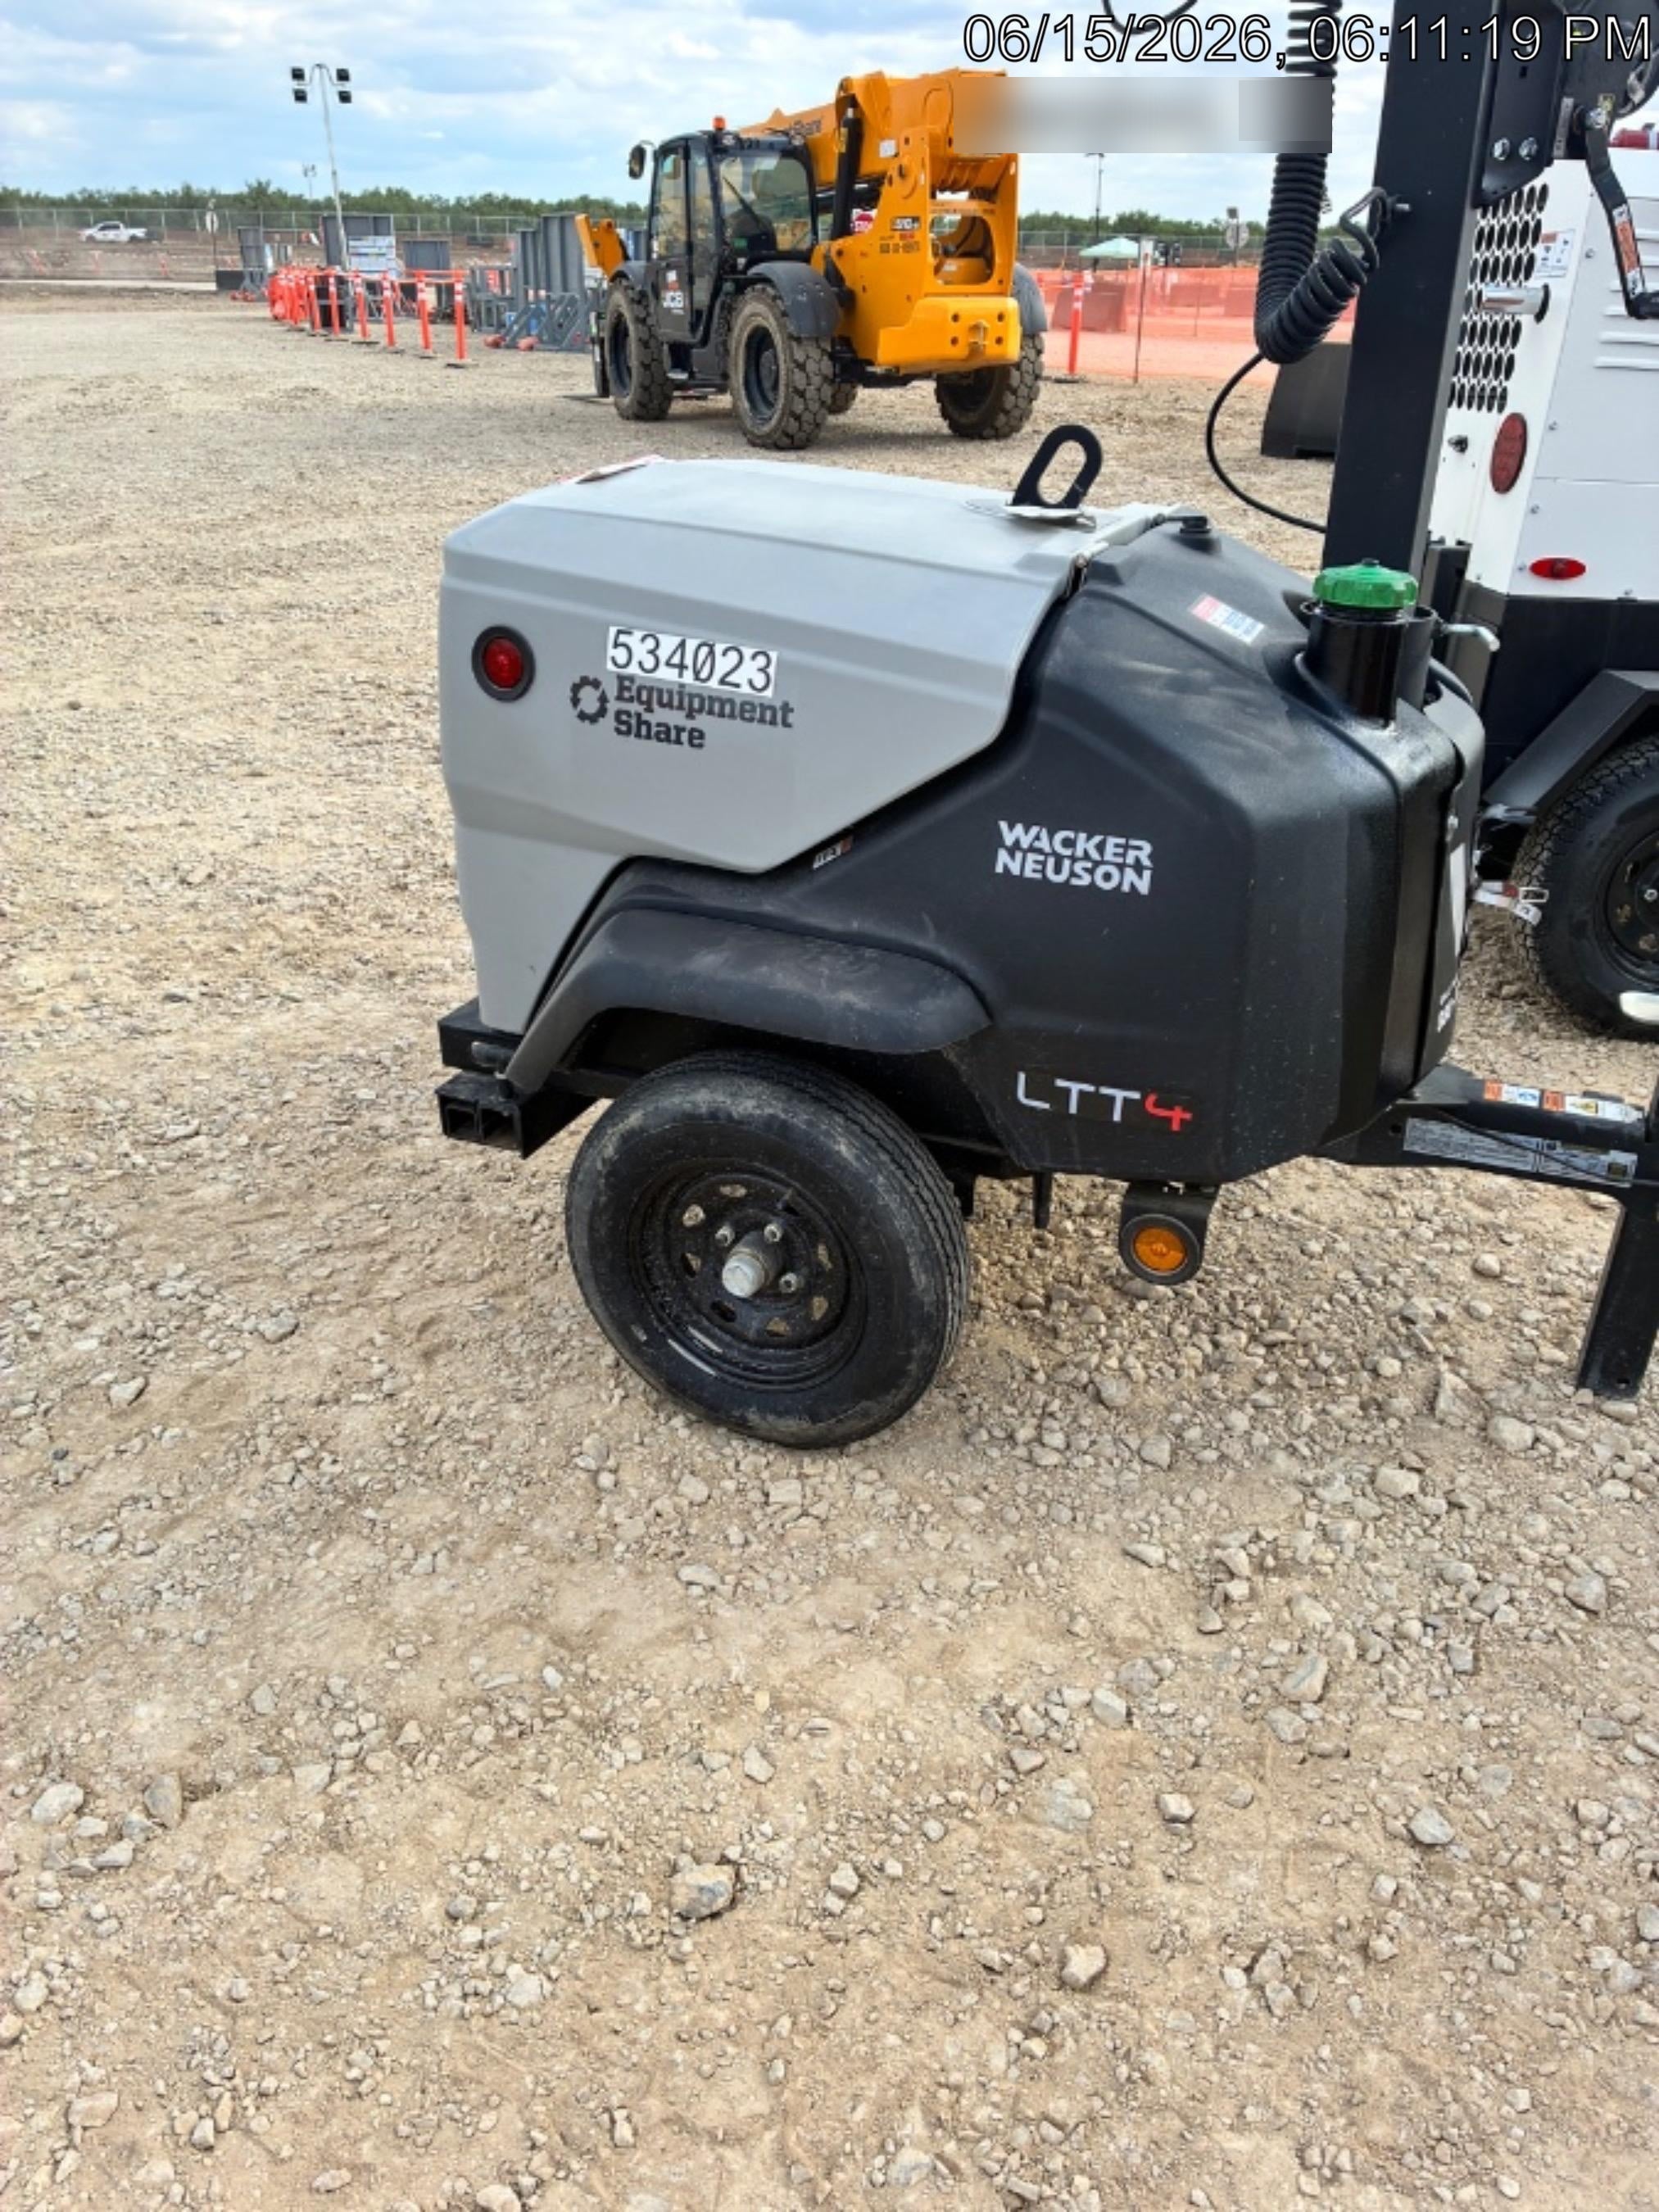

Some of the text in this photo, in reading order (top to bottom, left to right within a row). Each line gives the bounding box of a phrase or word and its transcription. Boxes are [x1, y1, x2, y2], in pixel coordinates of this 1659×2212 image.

[610, 629, 772, 693] 534023
[614, 674, 795, 728] Equipment
[614, 709, 705, 749] Share
[998, 820, 1154, 868] WACKER
[995, 847, 1153, 895] NEUSON
[1017, 1071, 1193, 1131] LTT4
